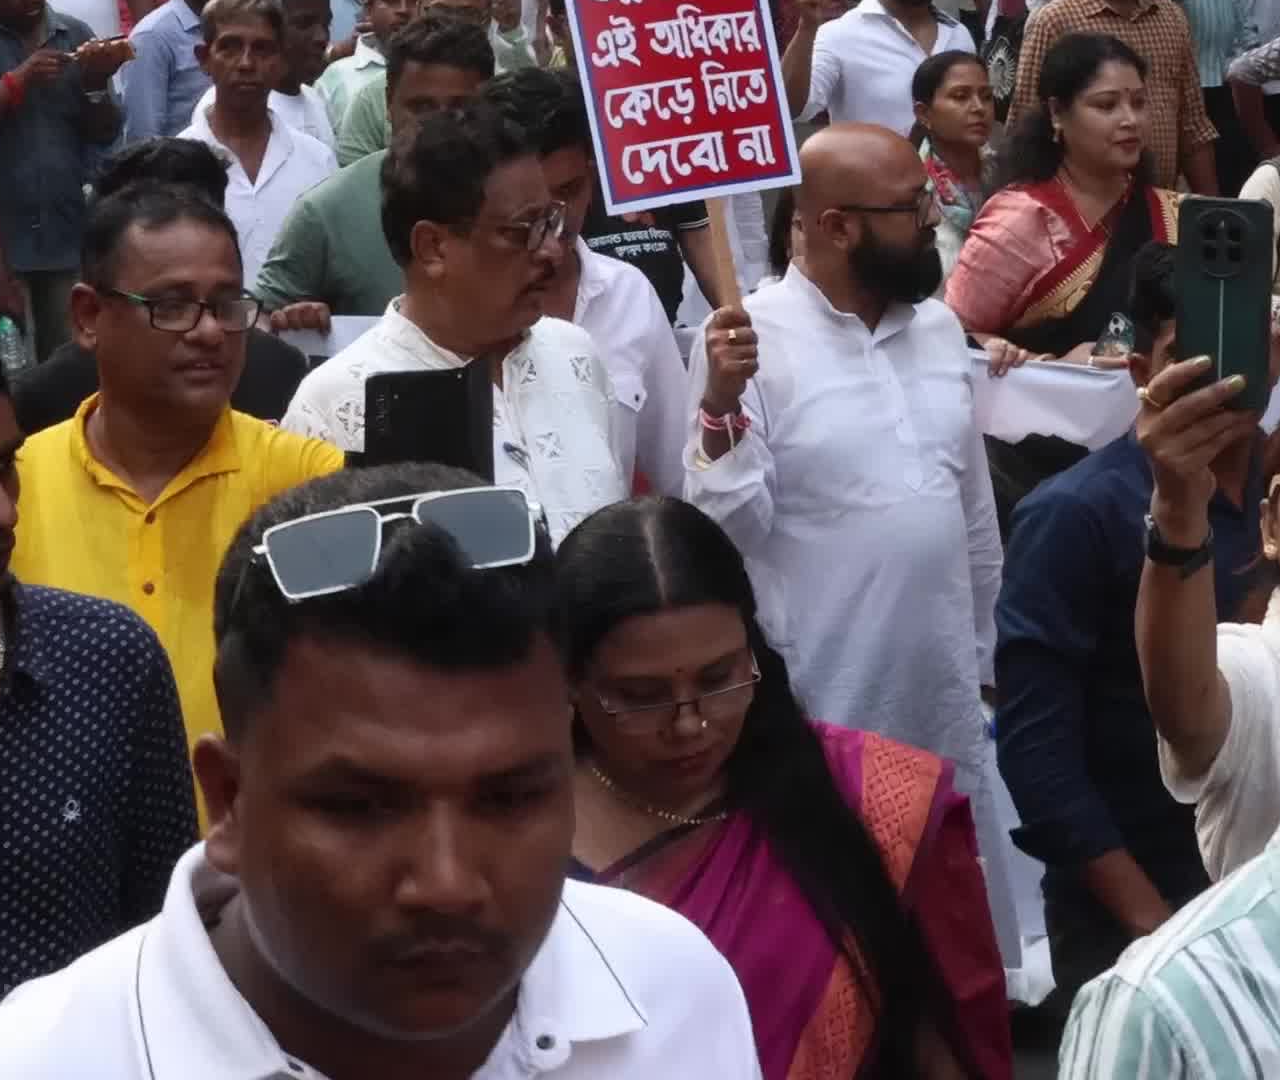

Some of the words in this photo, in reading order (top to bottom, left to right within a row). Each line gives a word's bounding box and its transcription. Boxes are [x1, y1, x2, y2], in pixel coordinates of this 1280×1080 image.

[591, 15, 642, 69] এই
[645, 3, 762, 60] অধিকার
[603, 76, 695, 130] কেড়ে
[700, 60, 769, 116] নিতে
[620, 127, 729, 186] দেবো
[736, 123, 777, 167] না
